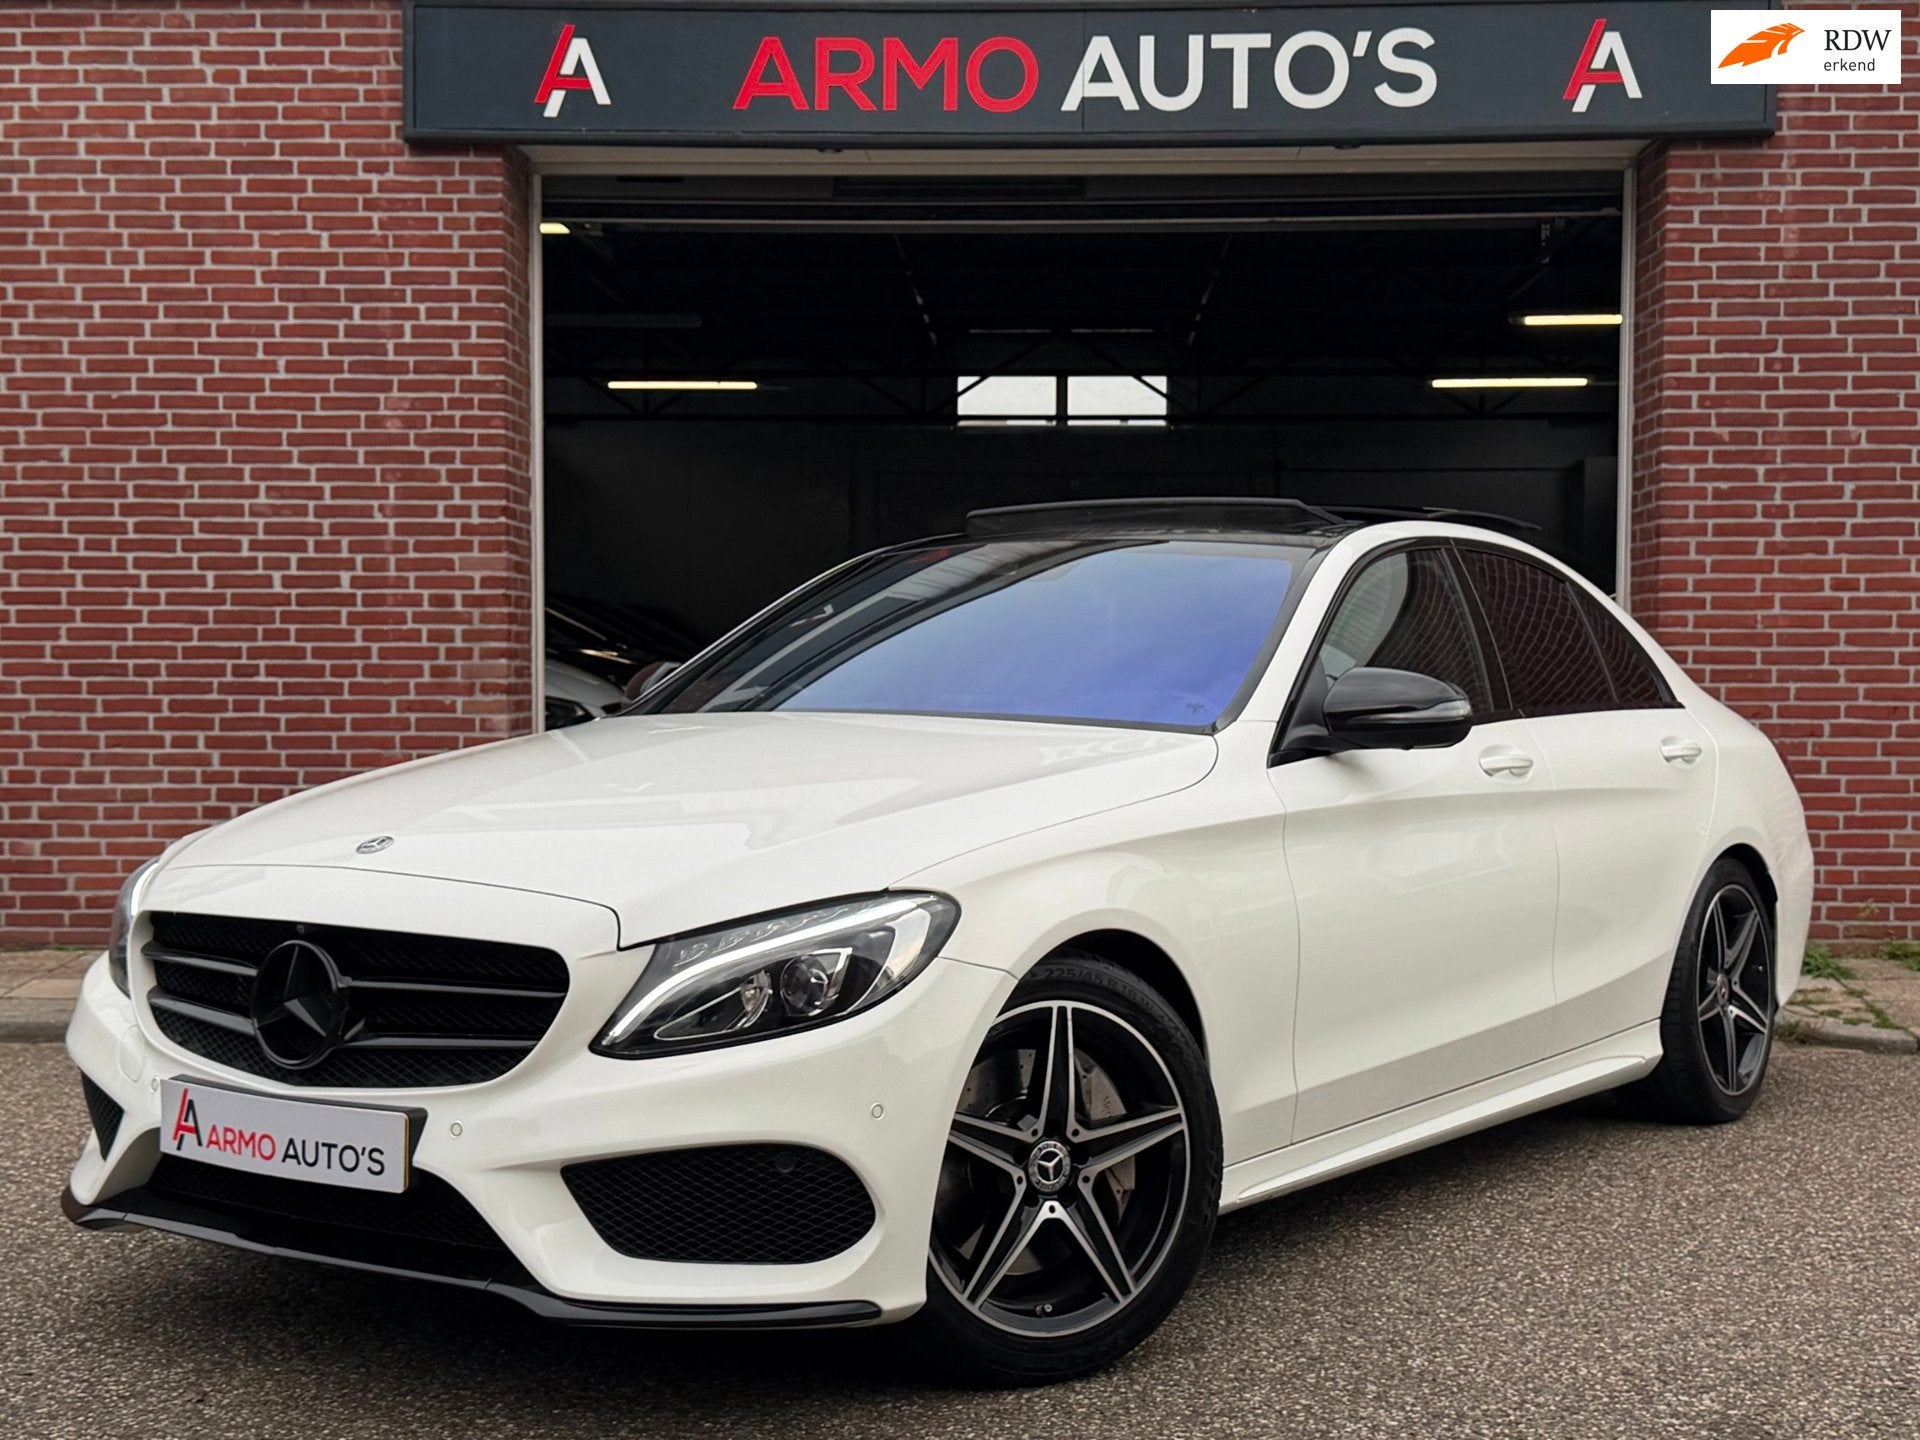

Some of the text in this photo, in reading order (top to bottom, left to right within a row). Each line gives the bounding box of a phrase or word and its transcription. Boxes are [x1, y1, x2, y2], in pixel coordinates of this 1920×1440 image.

[732, 27, 1438, 113] ARMO AUTO'S
[206, 1124, 386, 1177] ARMO AUTO'S
